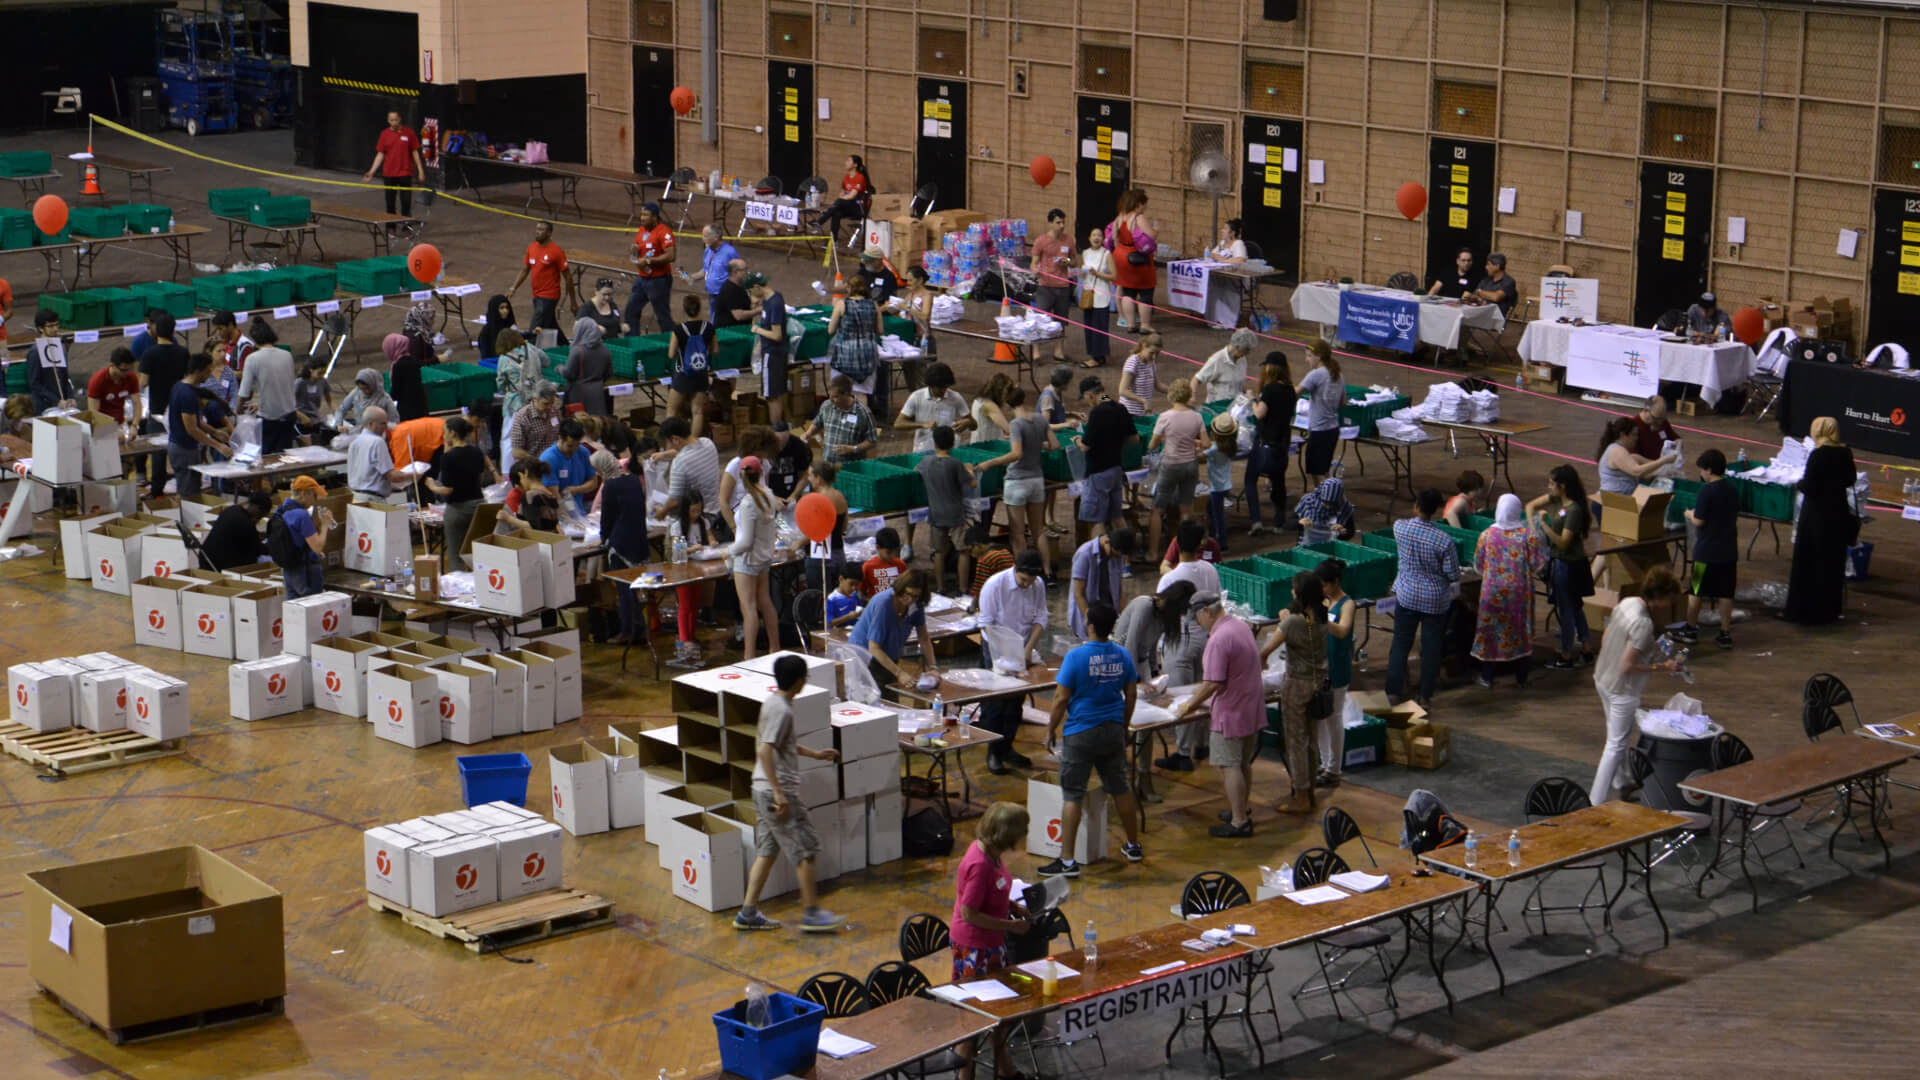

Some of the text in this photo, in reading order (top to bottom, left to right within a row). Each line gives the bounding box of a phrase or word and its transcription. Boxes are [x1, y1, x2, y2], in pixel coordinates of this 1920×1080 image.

[1266, 124, 1280, 136] 120
[1454, 146, 1466, 159] 121
[1668, 171, 1685, 185] 122
[746, 204, 793, 221] FIRST AID
[1171, 263, 1203, 278] HIAS
[1396, 313, 1411, 326] JDC
[44, 343, 61, 363] C
[1845, 407, 1890, 423] Heart to Heart
[1065, 961, 1241, 1032] REGISTRATION
